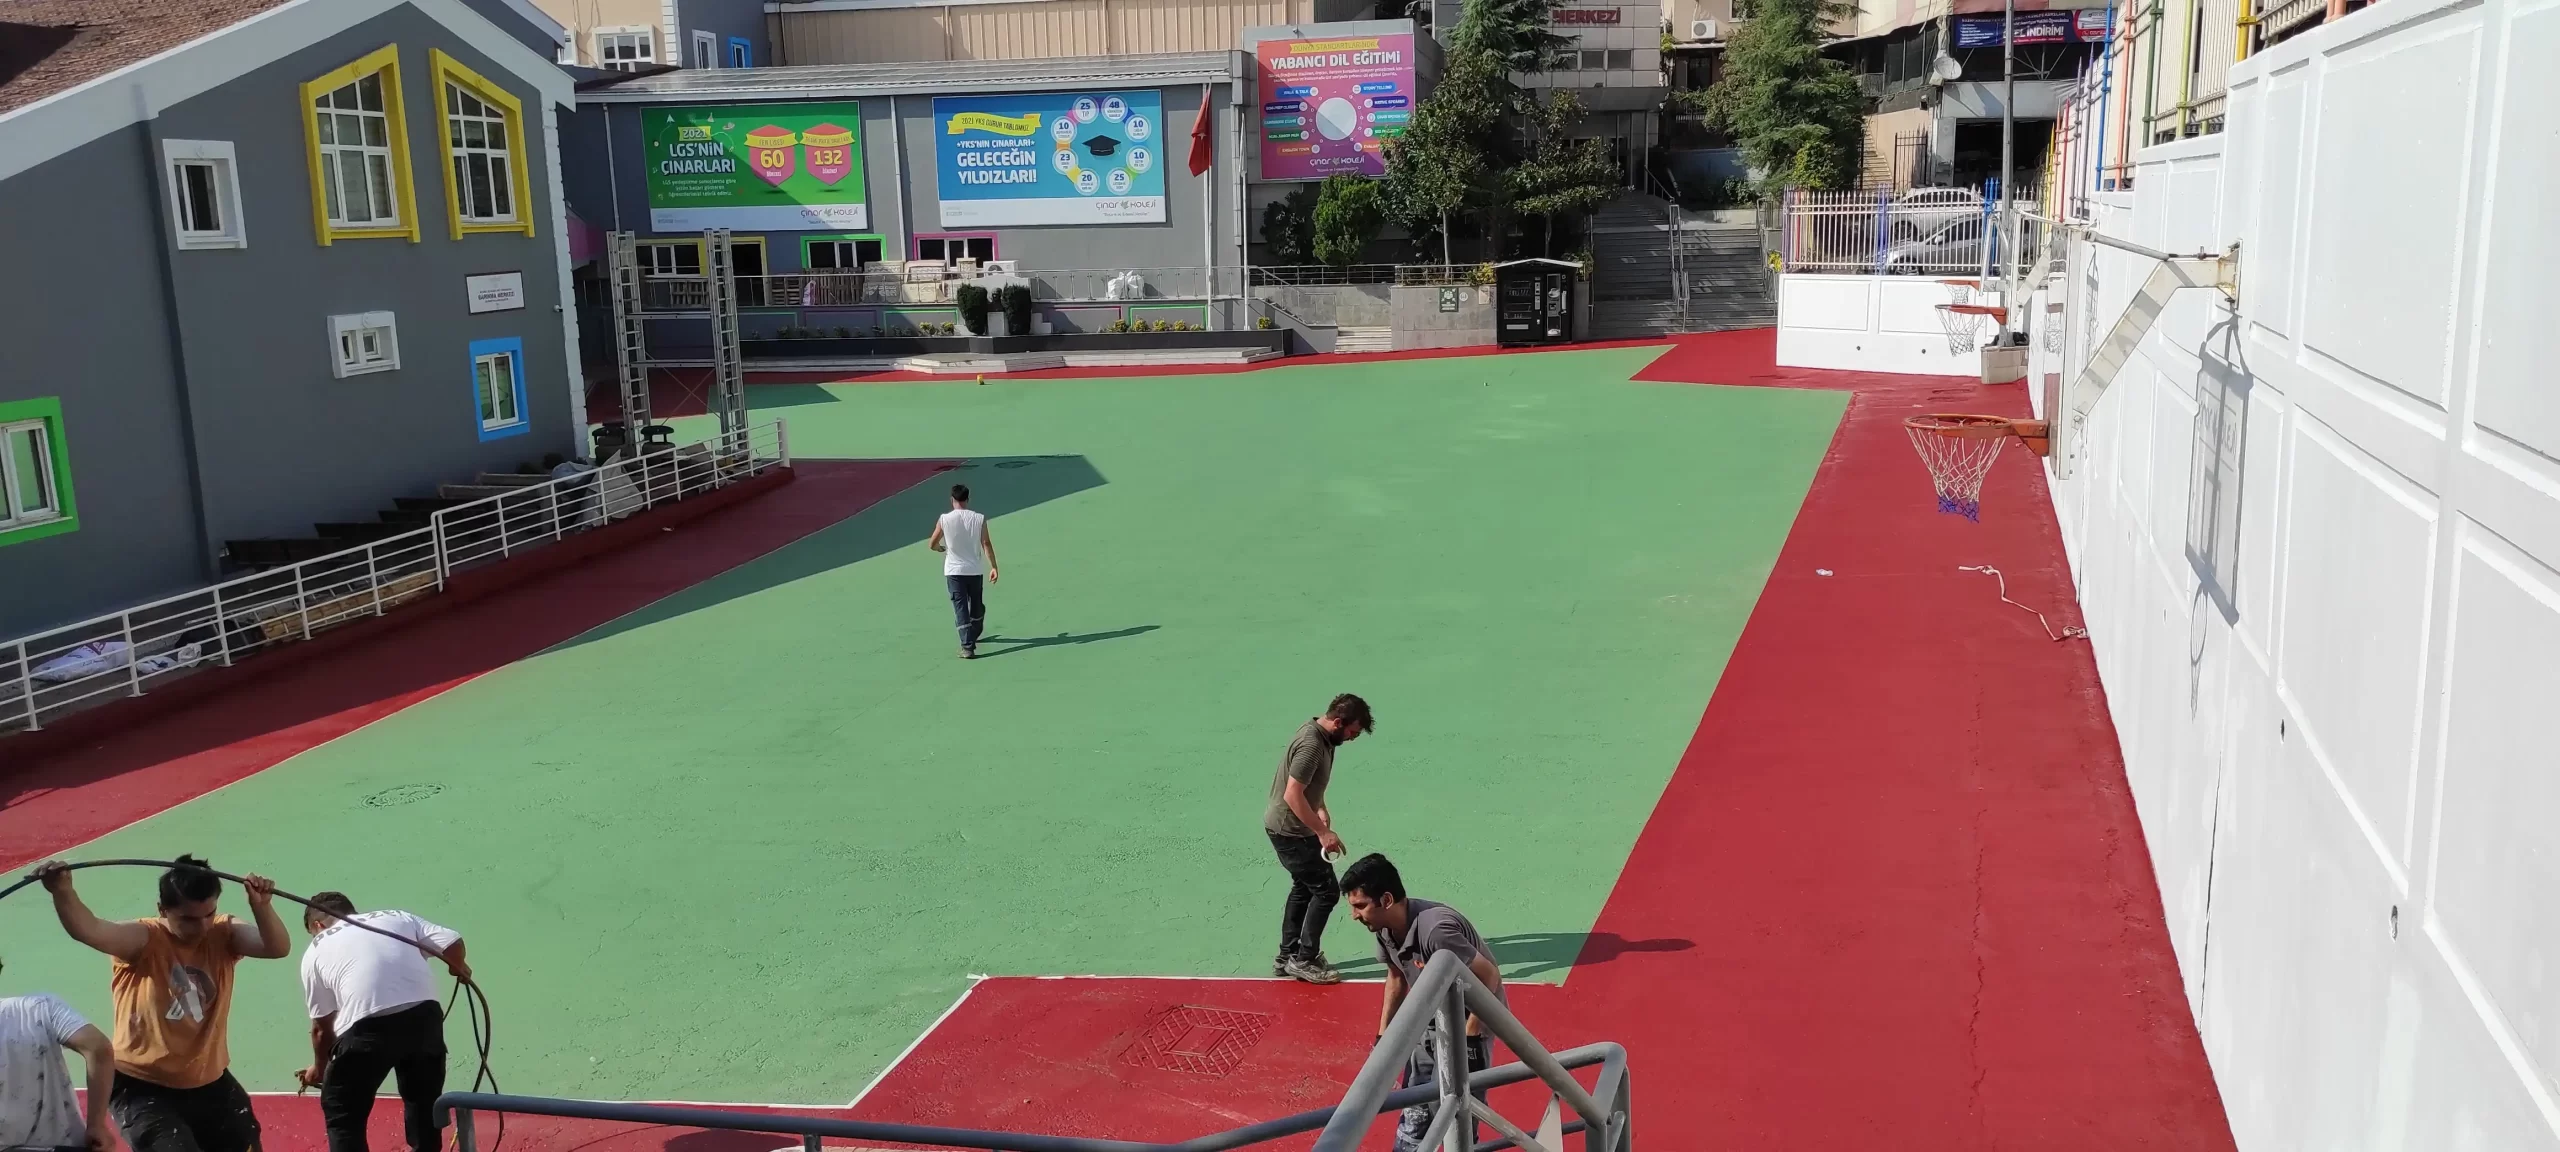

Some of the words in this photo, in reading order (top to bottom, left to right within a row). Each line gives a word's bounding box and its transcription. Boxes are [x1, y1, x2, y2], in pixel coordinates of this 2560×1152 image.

[2026, 24, 2065, 37] İNDİRİM!
[1270, 55, 1326, 70] YABANCI
[1329, 53, 1350, 67] DİL
[1353, 50, 1401, 66] EĞİTİMİ
[1080, 102, 1091, 110] 25
[1108, 101, 1120, 109] 48
[961, 117, 974, 125] 2021
[975, 117, 986, 126] YKS
[1003, 122, 1030, 132] TABLOMUZ
[1058, 122, 1070, 130] 10
[1133, 120, 1144, 128] 10
[682, 128, 707, 139] 2021
[669, 141, 724, 157] LGS'NİN
[991, 138, 1031, 149] ÇINARLARI
[760, 149, 785, 168] 60
[814, 149, 843, 166] 132
[956, 148, 1036, 167] GELECEĞİN
[1060, 153, 1071, 161] 23
[1133, 151, 1145, 159] 10
[661, 158, 736, 175] ÇINARLARI
[957, 168, 1037, 185] YILDIZLARI!
[1081, 174, 1093, 182] 20
[1114, 173, 1125, 181] 25
